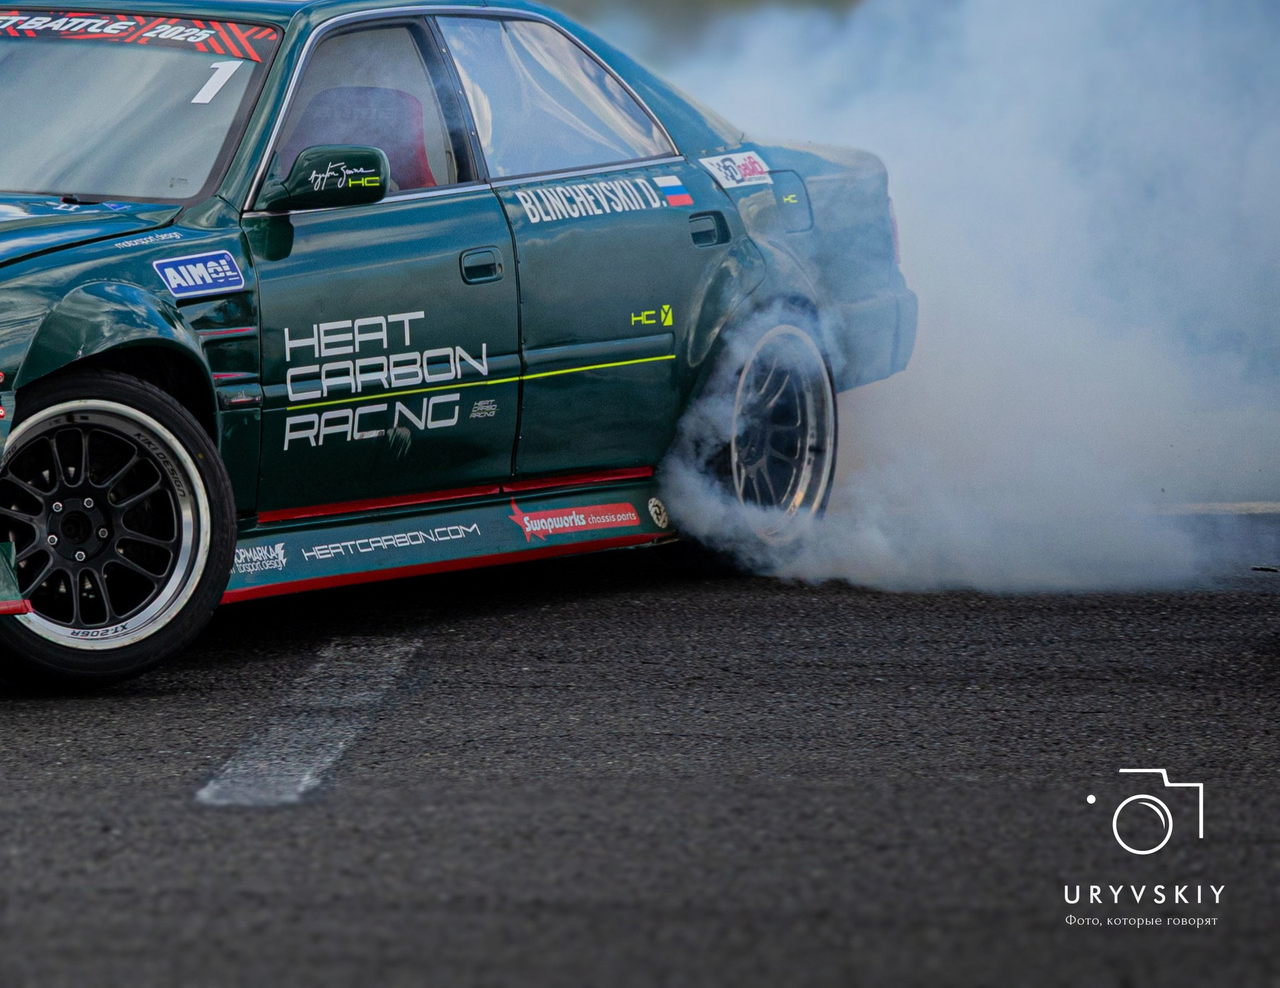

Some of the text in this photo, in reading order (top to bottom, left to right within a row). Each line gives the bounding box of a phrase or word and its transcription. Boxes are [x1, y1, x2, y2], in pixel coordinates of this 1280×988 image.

[16, 16, 136, 34] BATTLE
[142, 24, 216, 43] 2025
[191, 60, 244, 104] 1
[348, 176, 380, 188] HC
[634, 177, 668, 209] D.
[163, 258, 240, 289] AIMOL
[631, 310, 656, 326] HC
[284, 311, 425, 362] HEAT
[286, 343, 489, 402] CARBON
[523, 511, 637, 533] Swapworks chassis parts
[301, 523, 482, 561] HEATCARBON.COM
